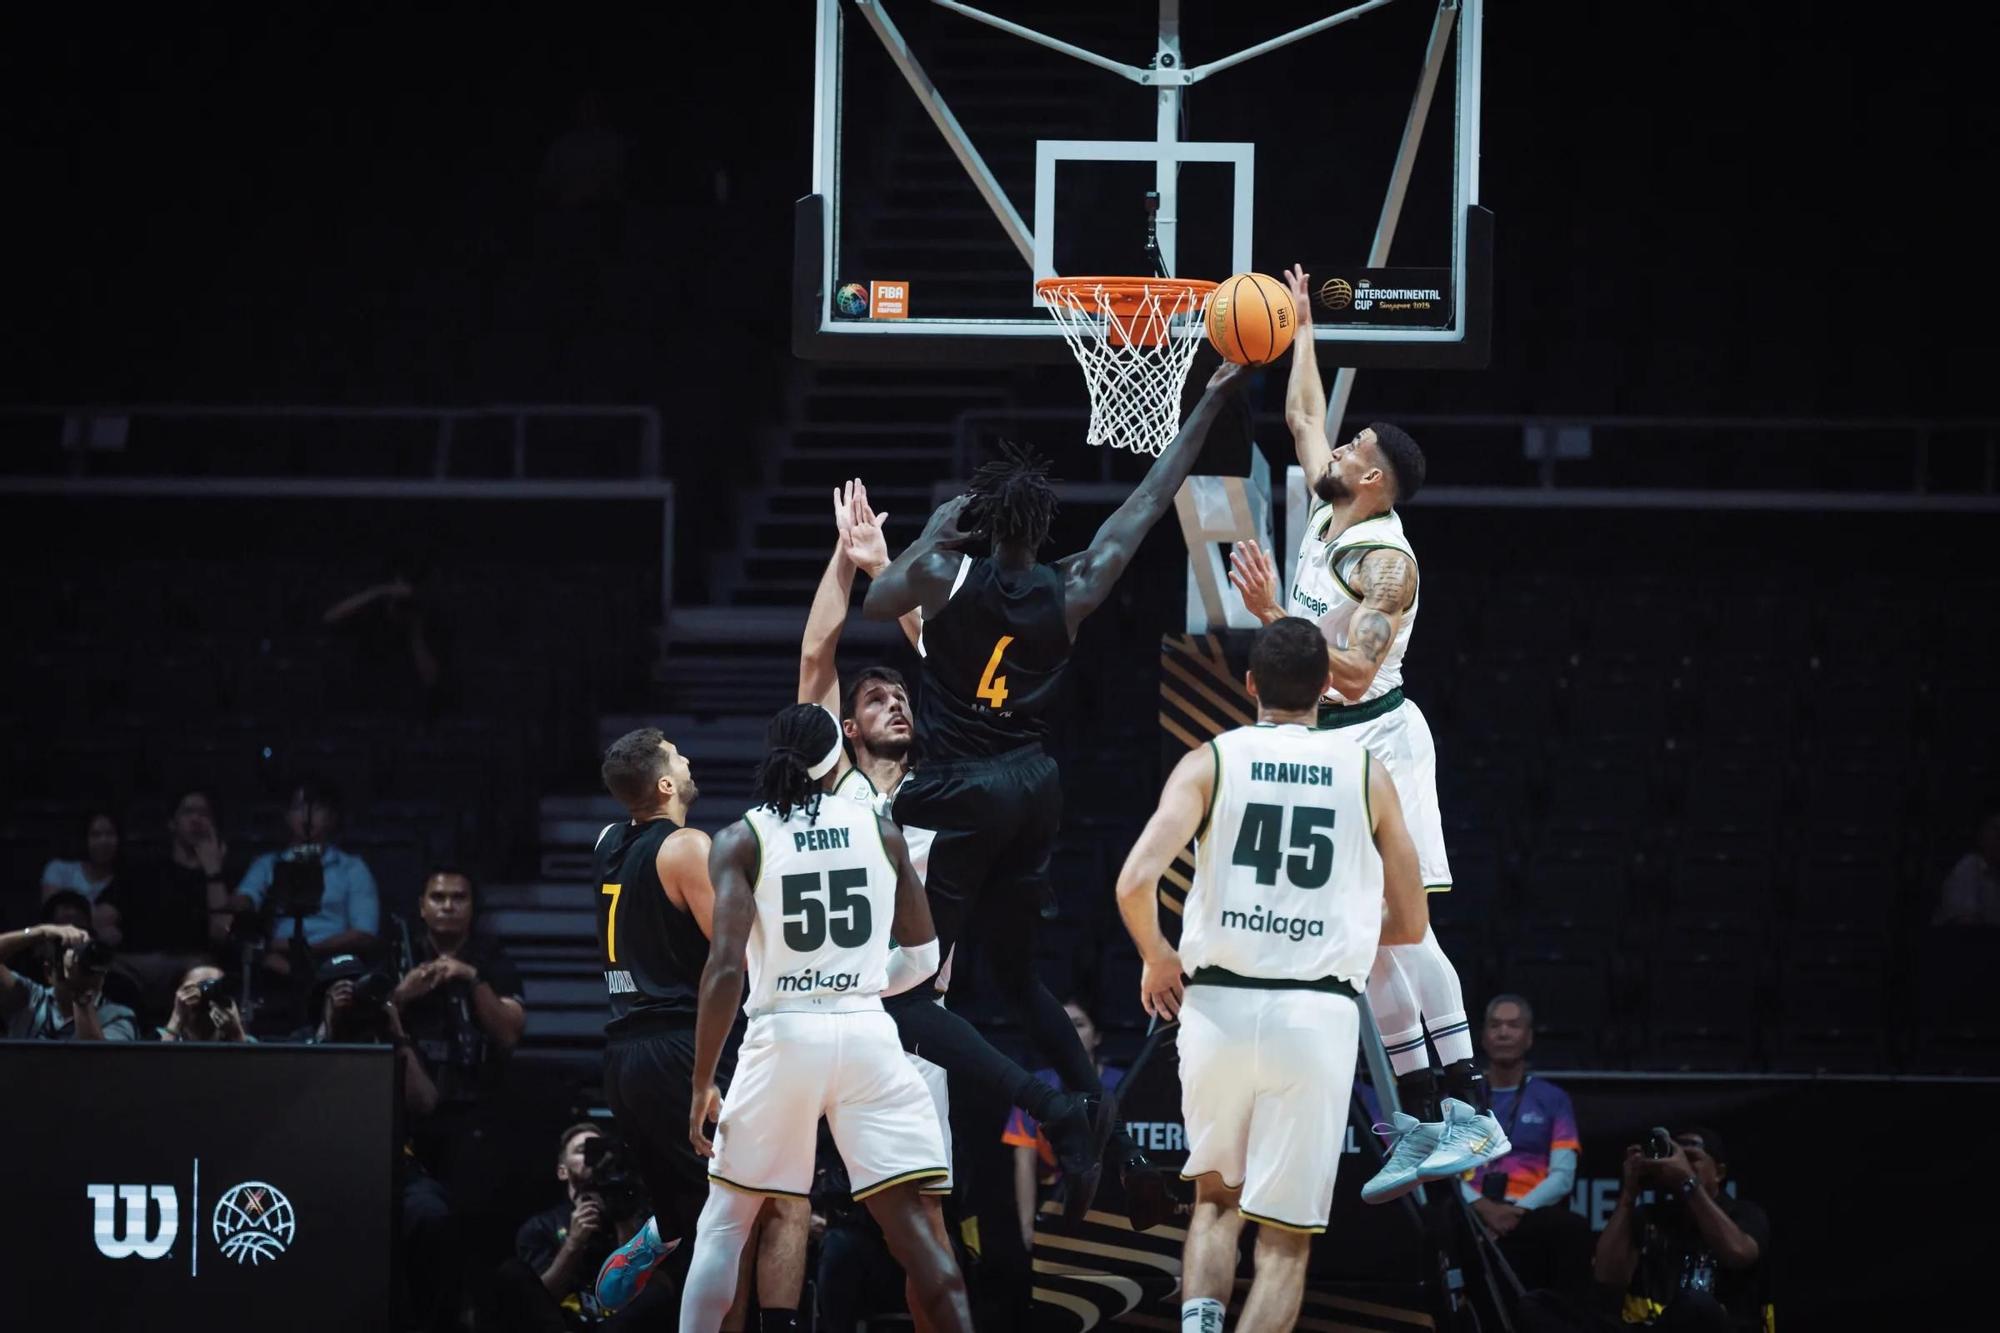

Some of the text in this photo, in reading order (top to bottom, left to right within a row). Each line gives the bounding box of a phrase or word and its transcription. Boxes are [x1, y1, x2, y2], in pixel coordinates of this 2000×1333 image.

[878, 286, 904, 299] FIBA
[1355, 289, 1441, 300] INTERCONTINENTAL
[1355, 300, 1373, 310] CUP
[1277, 308, 1287, 329] FIBA
[976, 635, 1015, 707] 4
[1251, 762, 1333, 787] KRAVISH
[793, 827, 850, 852] PERRY
[1232, 802, 1336, 889] 45
[781, 867, 872, 952] 55
[601, 883, 622, 963] 7
[87, 1184, 178, 1260] W
